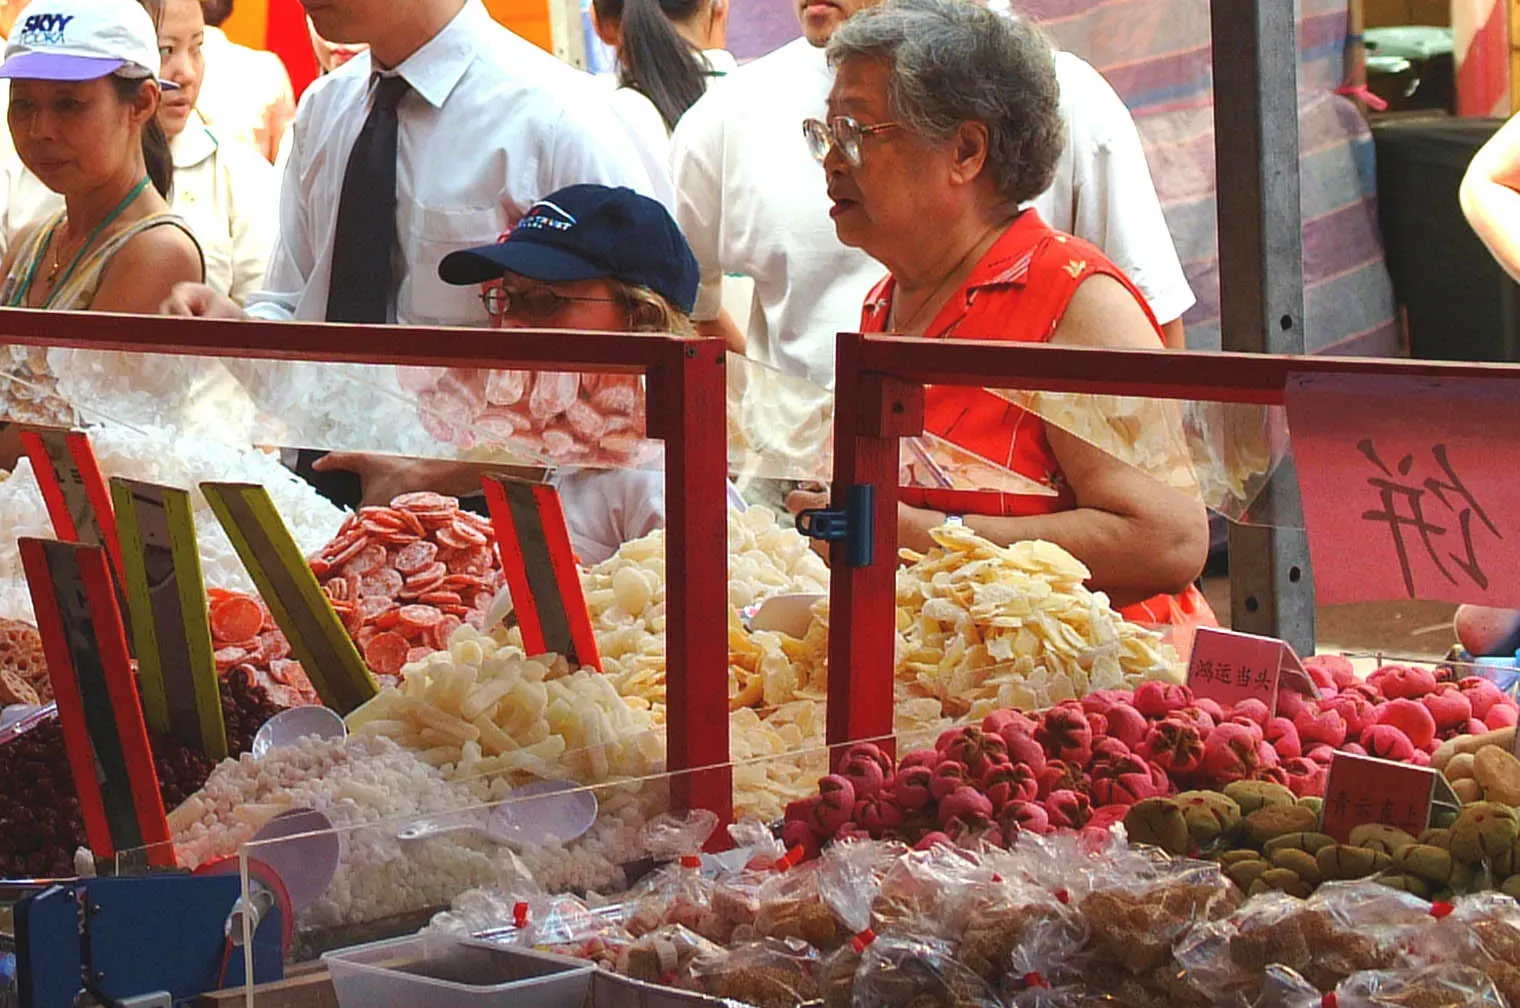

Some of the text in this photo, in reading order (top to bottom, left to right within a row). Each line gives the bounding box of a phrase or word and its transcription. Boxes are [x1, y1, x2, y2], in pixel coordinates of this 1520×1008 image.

[21, 13, 75, 34] SKYY
[1194, 659, 1272, 693] 鸿运当头
